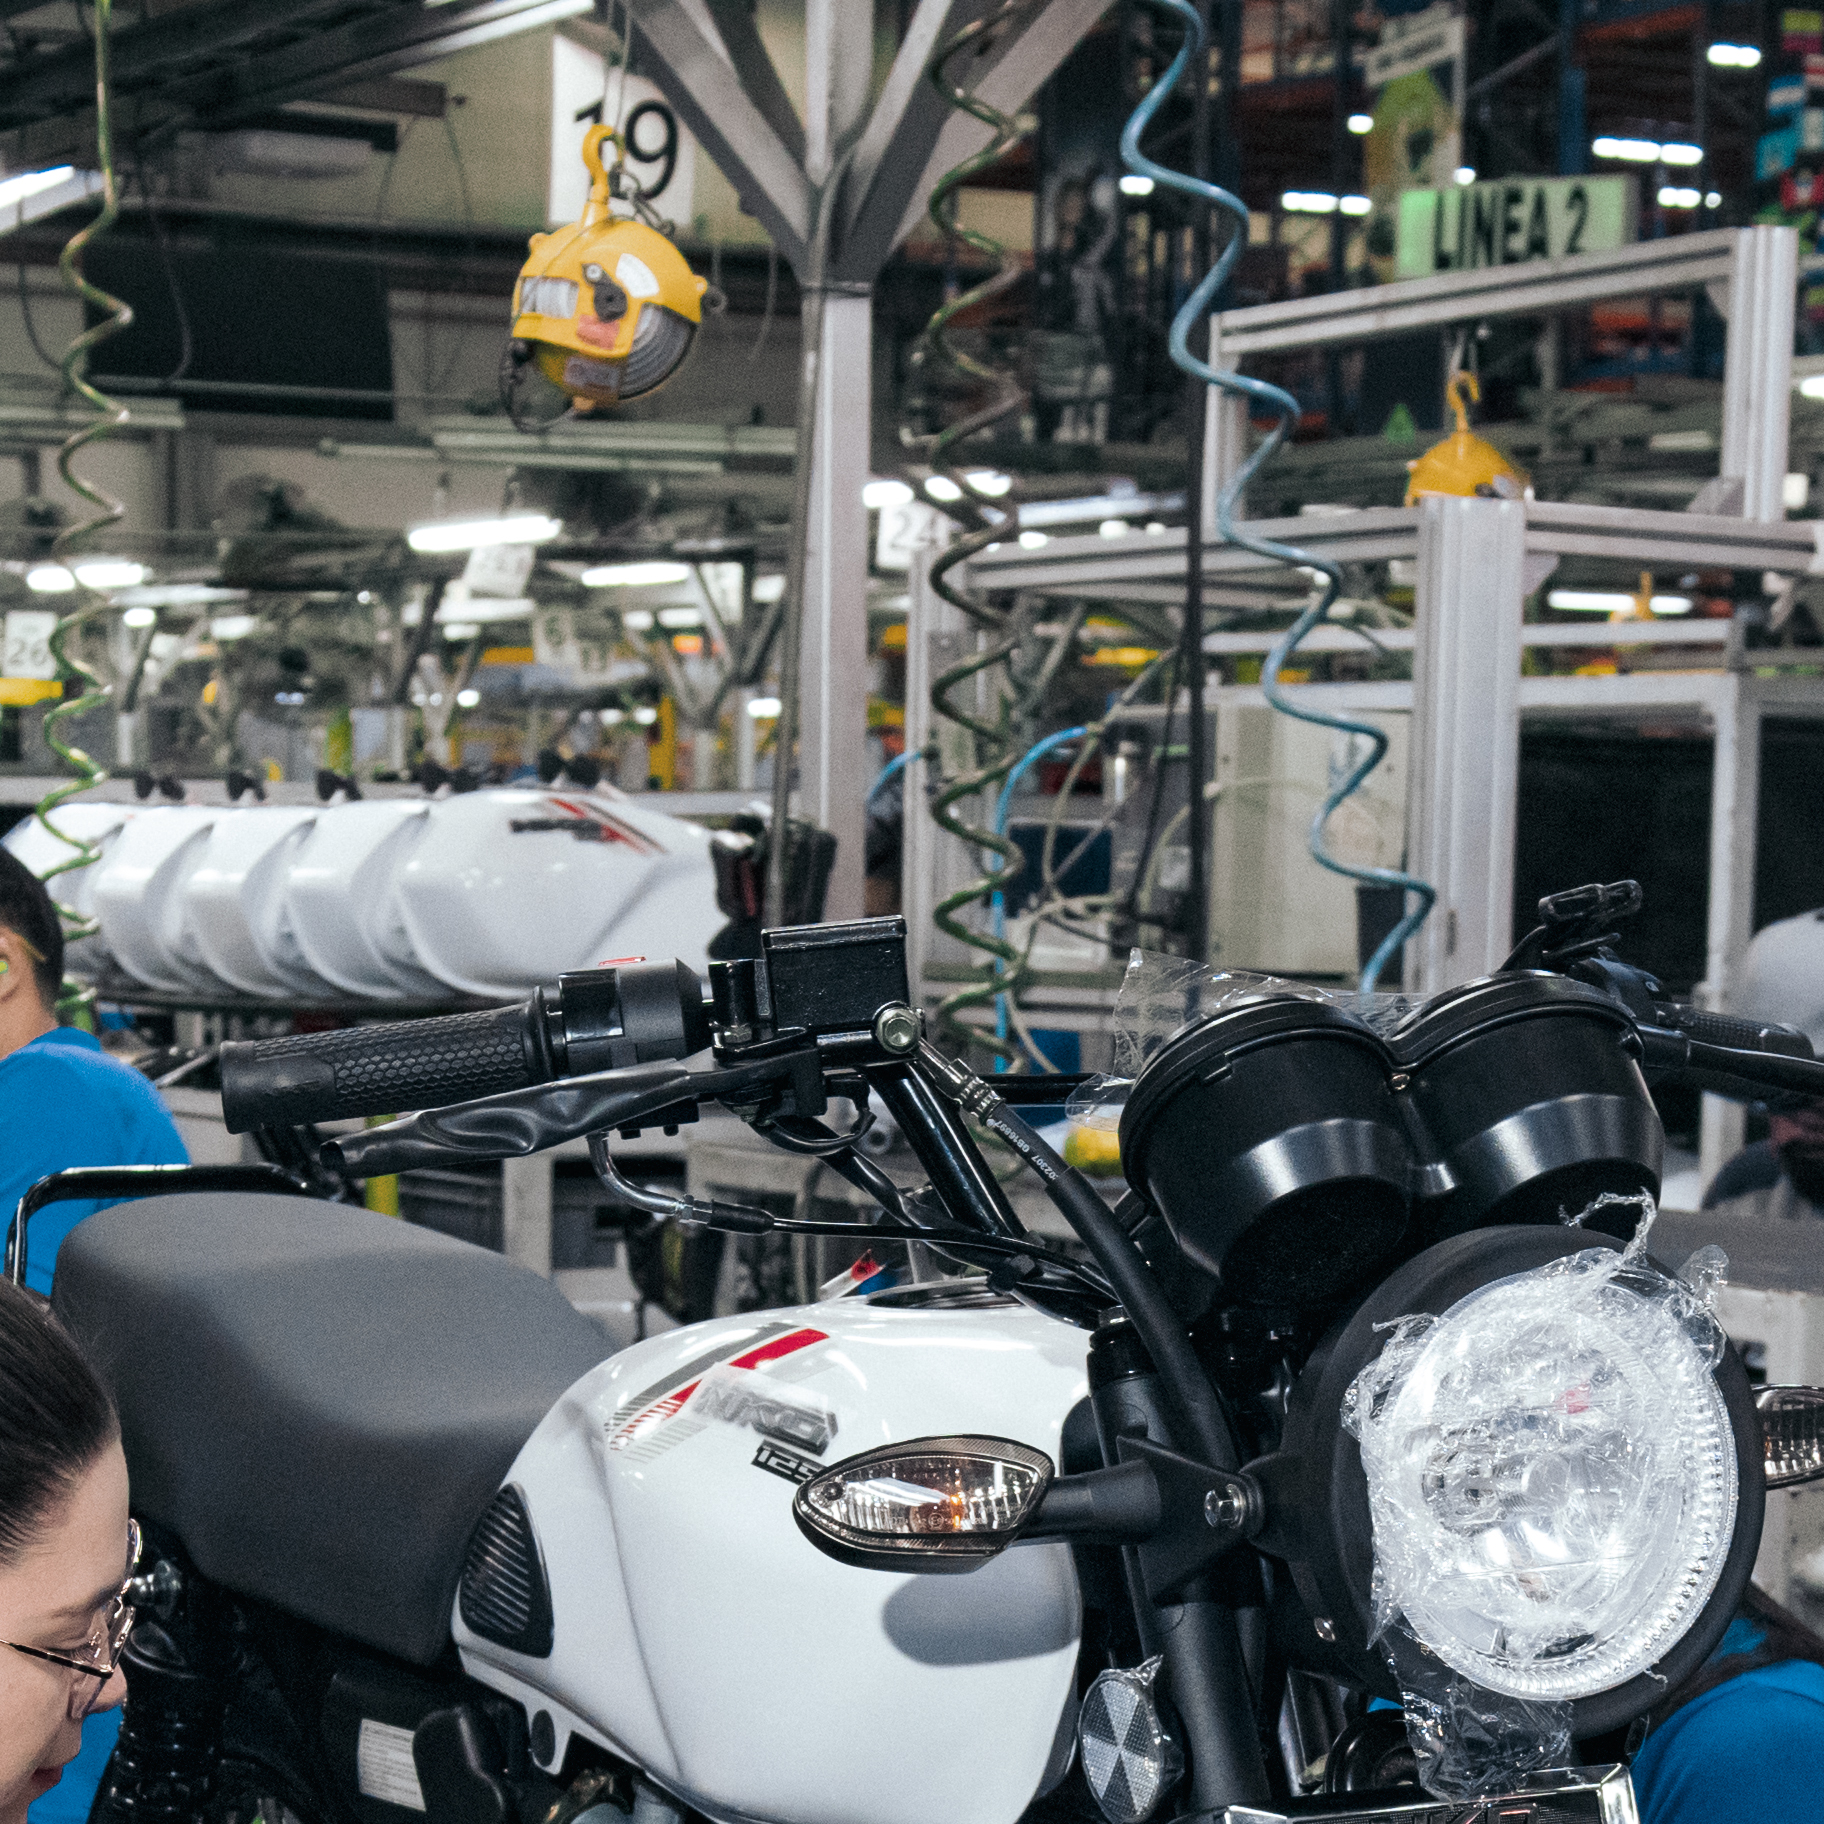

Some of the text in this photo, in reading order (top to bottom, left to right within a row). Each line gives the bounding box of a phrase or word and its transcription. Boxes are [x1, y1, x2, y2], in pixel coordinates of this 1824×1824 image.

[1434, 185, 1590, 272] LINEA 2
[693, 1377, 836, 1455] NKD
